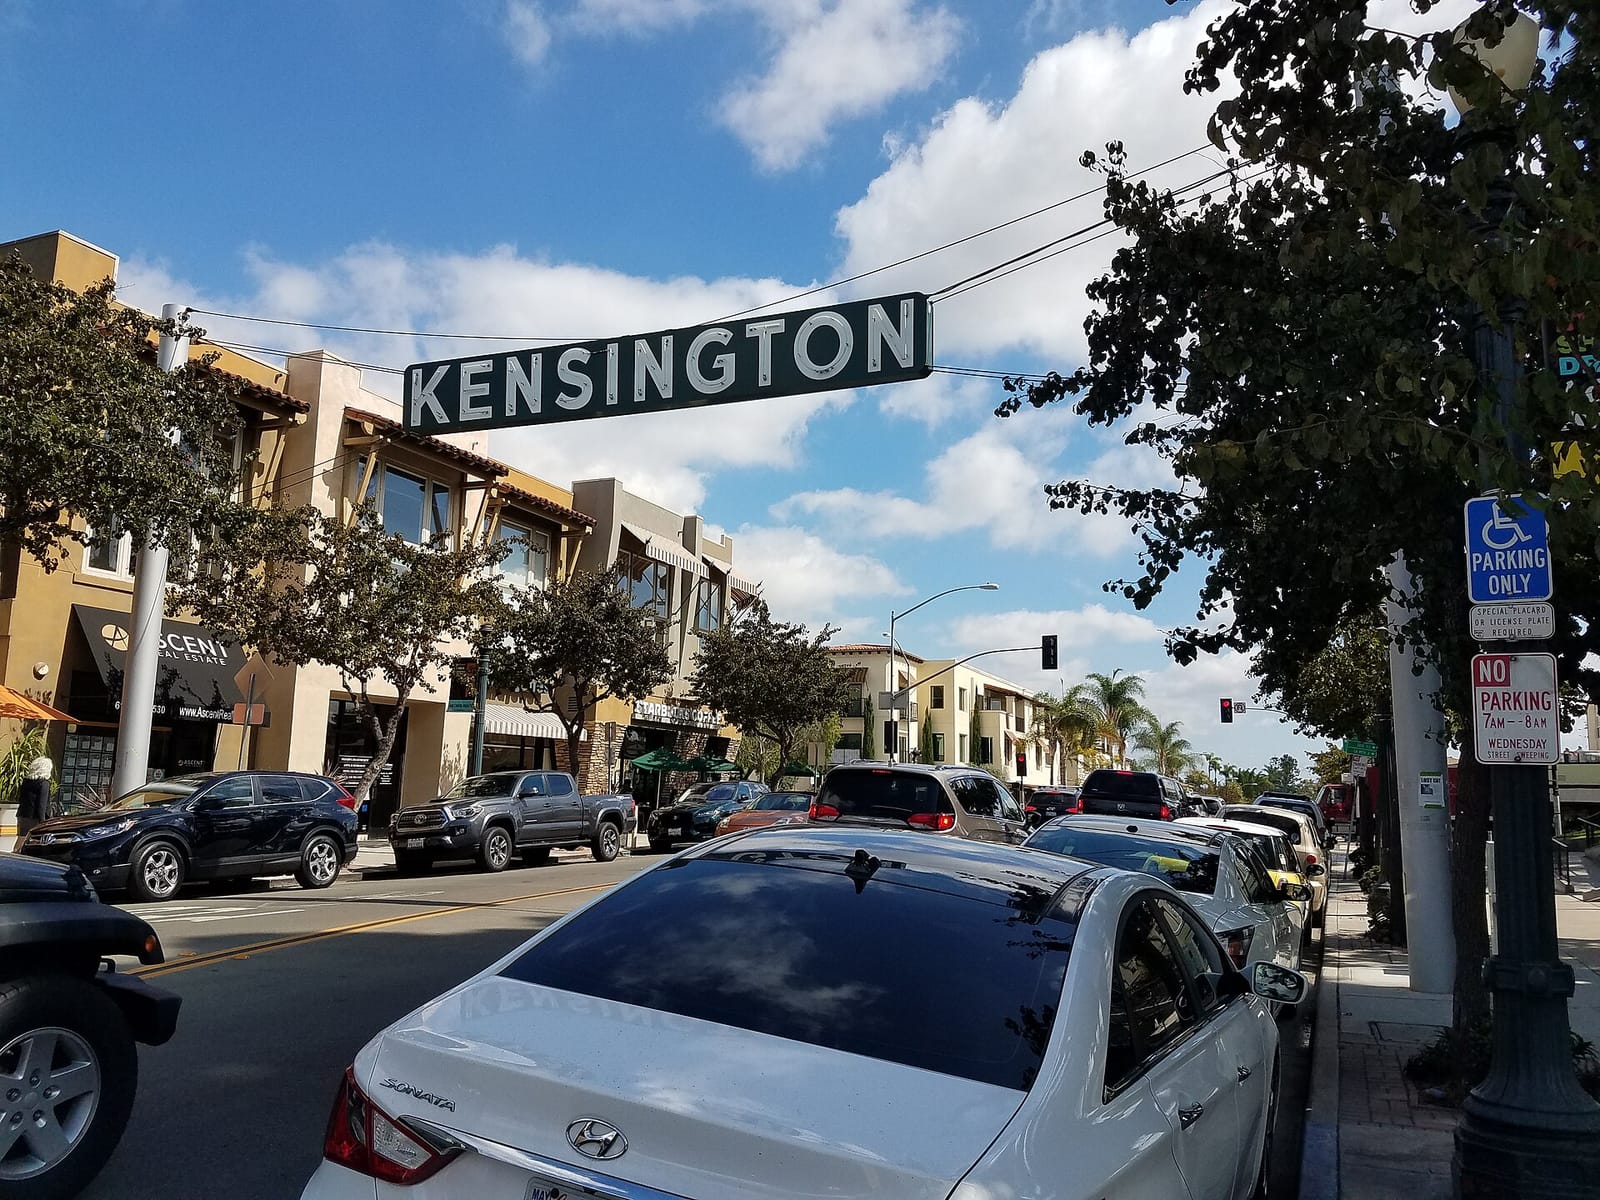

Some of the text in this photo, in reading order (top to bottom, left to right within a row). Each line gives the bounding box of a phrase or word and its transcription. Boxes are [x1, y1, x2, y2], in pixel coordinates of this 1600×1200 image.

[410, 298, 915, 427] KENSINGTON
[1472, 548, 1546, 572] PARKING
[1488, 573, 1531, 595] ONLY
[1477, 605, 1546, 616] SPECIAL PLACARD
[1489, 618, 1522, 626] LICENSE
[1527, 616, 1550, 625] PLATE
[1492, 628, 1532, 637] REQUIRED
[158, 633, 228, 658] SCENT
[158, 650, 227, 666] EAL ESTATE
[1479, 659, 1506, 683] NO
[1481, 691, 1552, 711] PARKING
[1488, 738, 1547, 750] WEDNESDAY
[1487, 750, 1549, 760] STREET SWEEPING
[379, 1078, 456, 1113] SONATA
